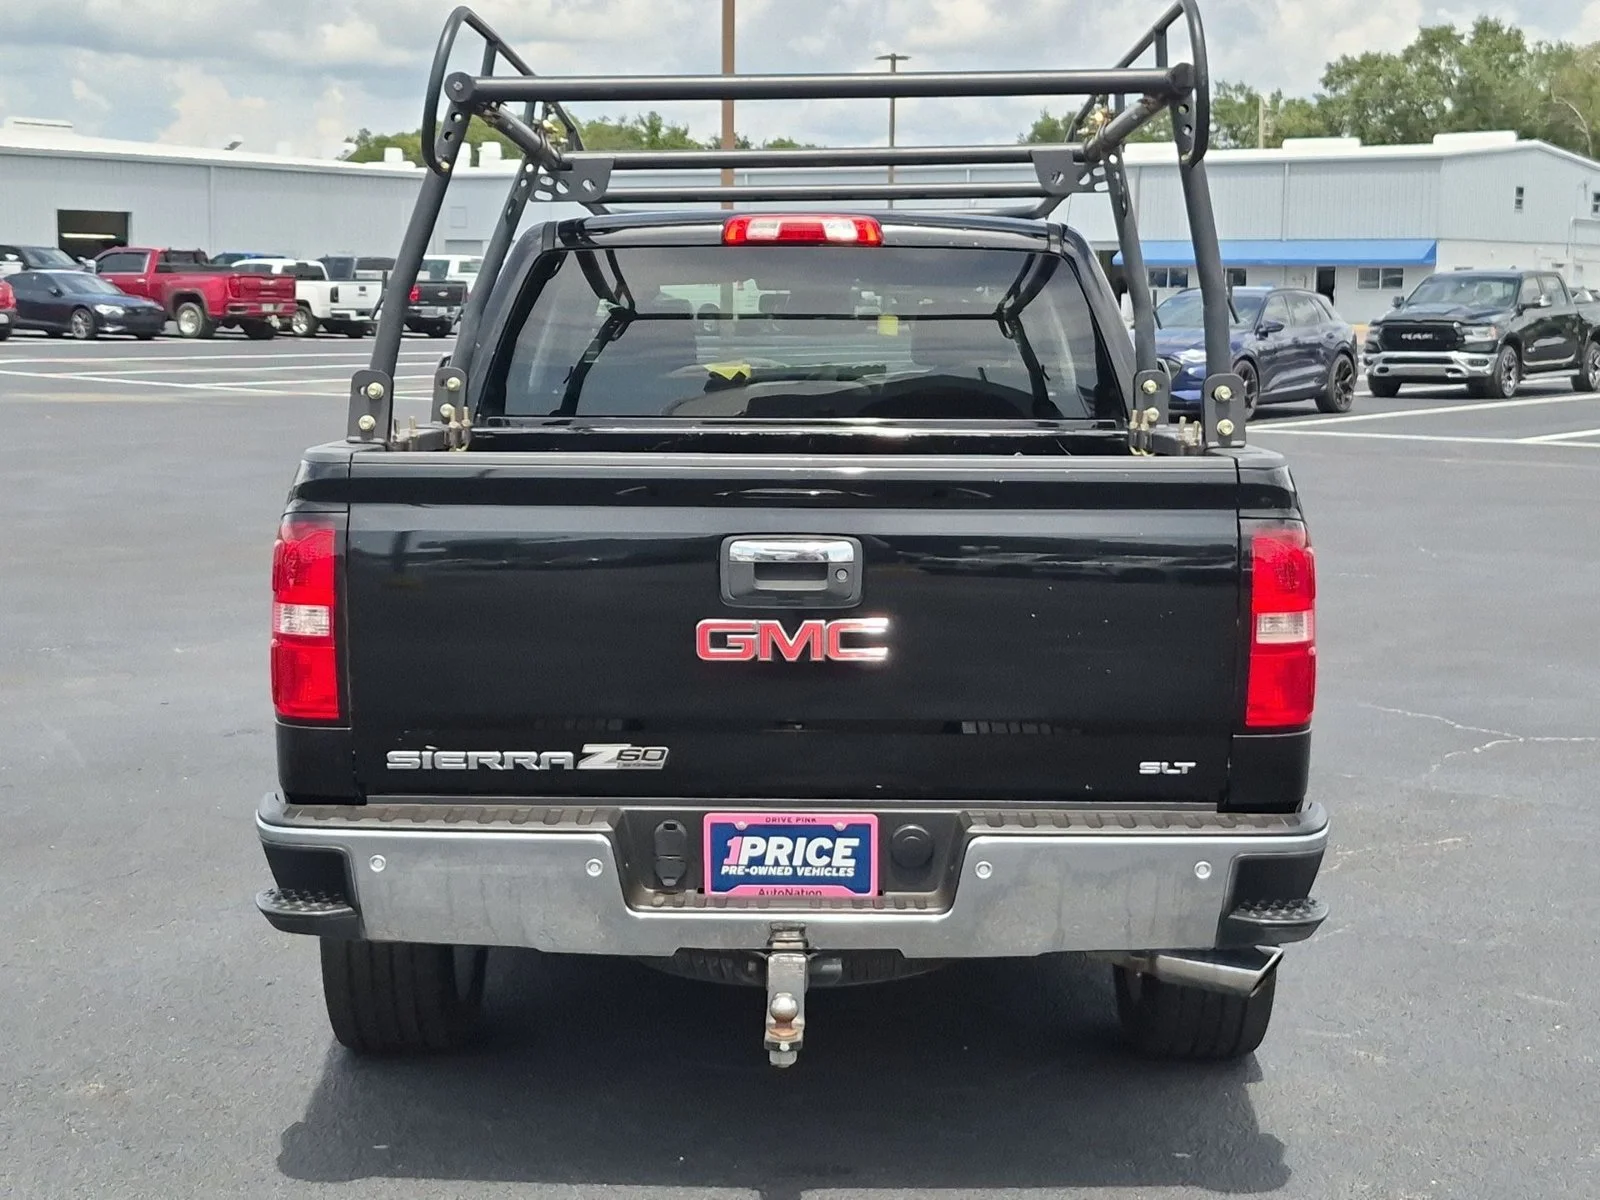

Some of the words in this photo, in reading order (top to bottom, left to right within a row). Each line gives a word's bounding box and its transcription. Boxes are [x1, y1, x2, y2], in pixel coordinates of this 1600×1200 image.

[696, 617, 889, 662] GMC
[386, 750, 574, 770] SIERRA
[1139, 761, 1197, 774] SLT
[721, 865, 793, 877] PRE-OWNED
[796, 866, 855, 878] VEHICLES
[758, 888, 822, 896] AutoNation
